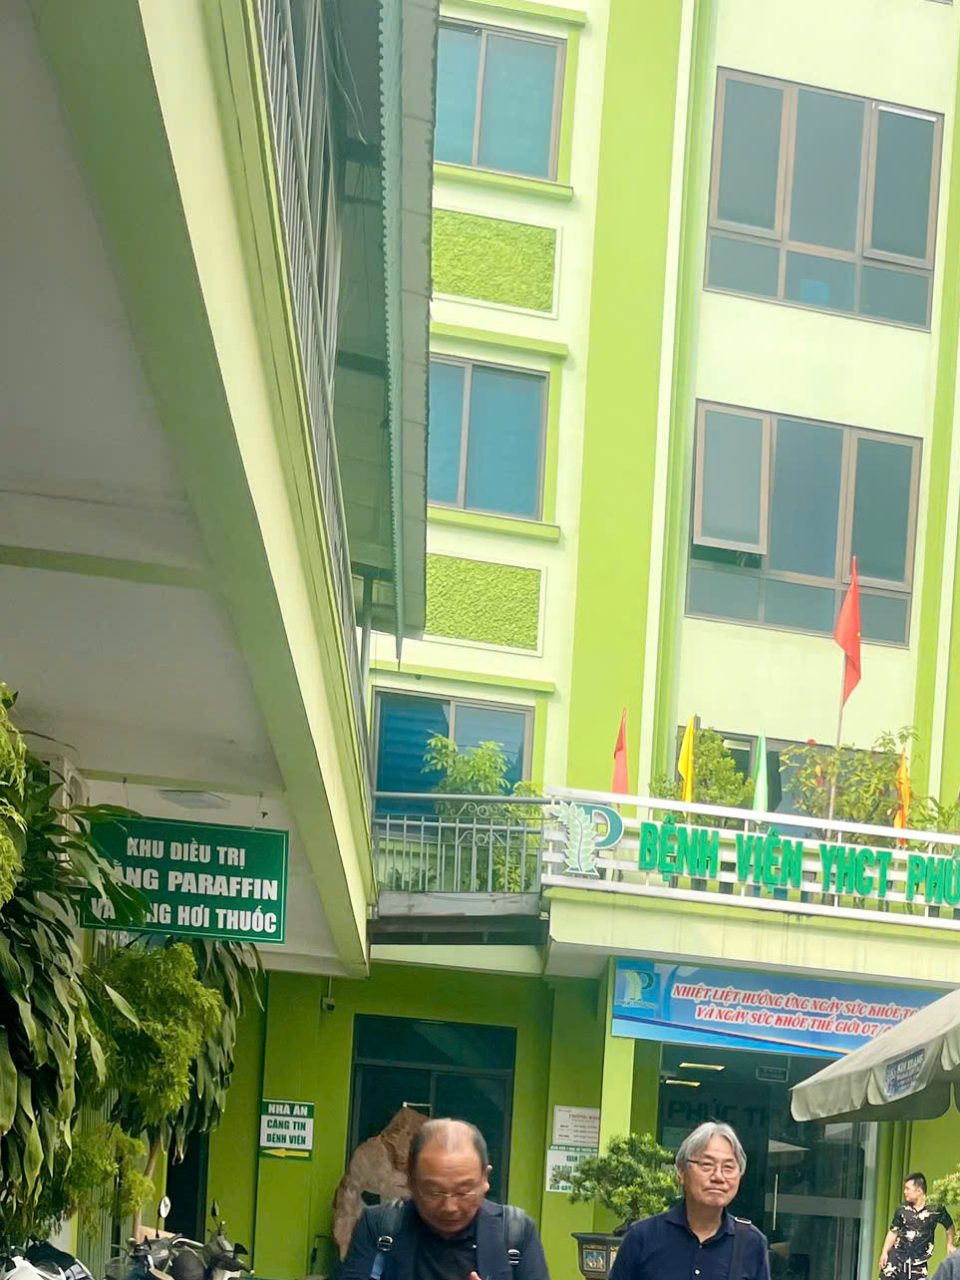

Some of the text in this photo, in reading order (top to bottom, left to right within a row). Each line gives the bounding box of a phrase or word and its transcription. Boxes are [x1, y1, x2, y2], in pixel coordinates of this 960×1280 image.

[126, 836, 165, 859] KHU
[216, 846, 246, 870] TRỊ
[638, 815, 720, 881] BỆNH
[735, 825, 803, 893] VIỆN
[819, 843, 893, 898] YHCT
[168, 870, 278, 901] PARAFFIN
[177, 903, 210, 928] HƠI
[215, 905, 277, 934] THUỐC
[673, 983, 713, 1002] NHIỆT
[713, 986, 740, 1005] LIỆT
[811, 997, 843, 1013] NGÀY
[844, 1000, 868, 1015] SỨC
[696, 1006, 715, 1019] VÀ
[716, 1008, 749, 1023] NGÀY
[751, 1009, 774, 1025] SỨC
[811, 1015, 834, 1032] THẾ
[293, 1120, 307, 1131] TIN
